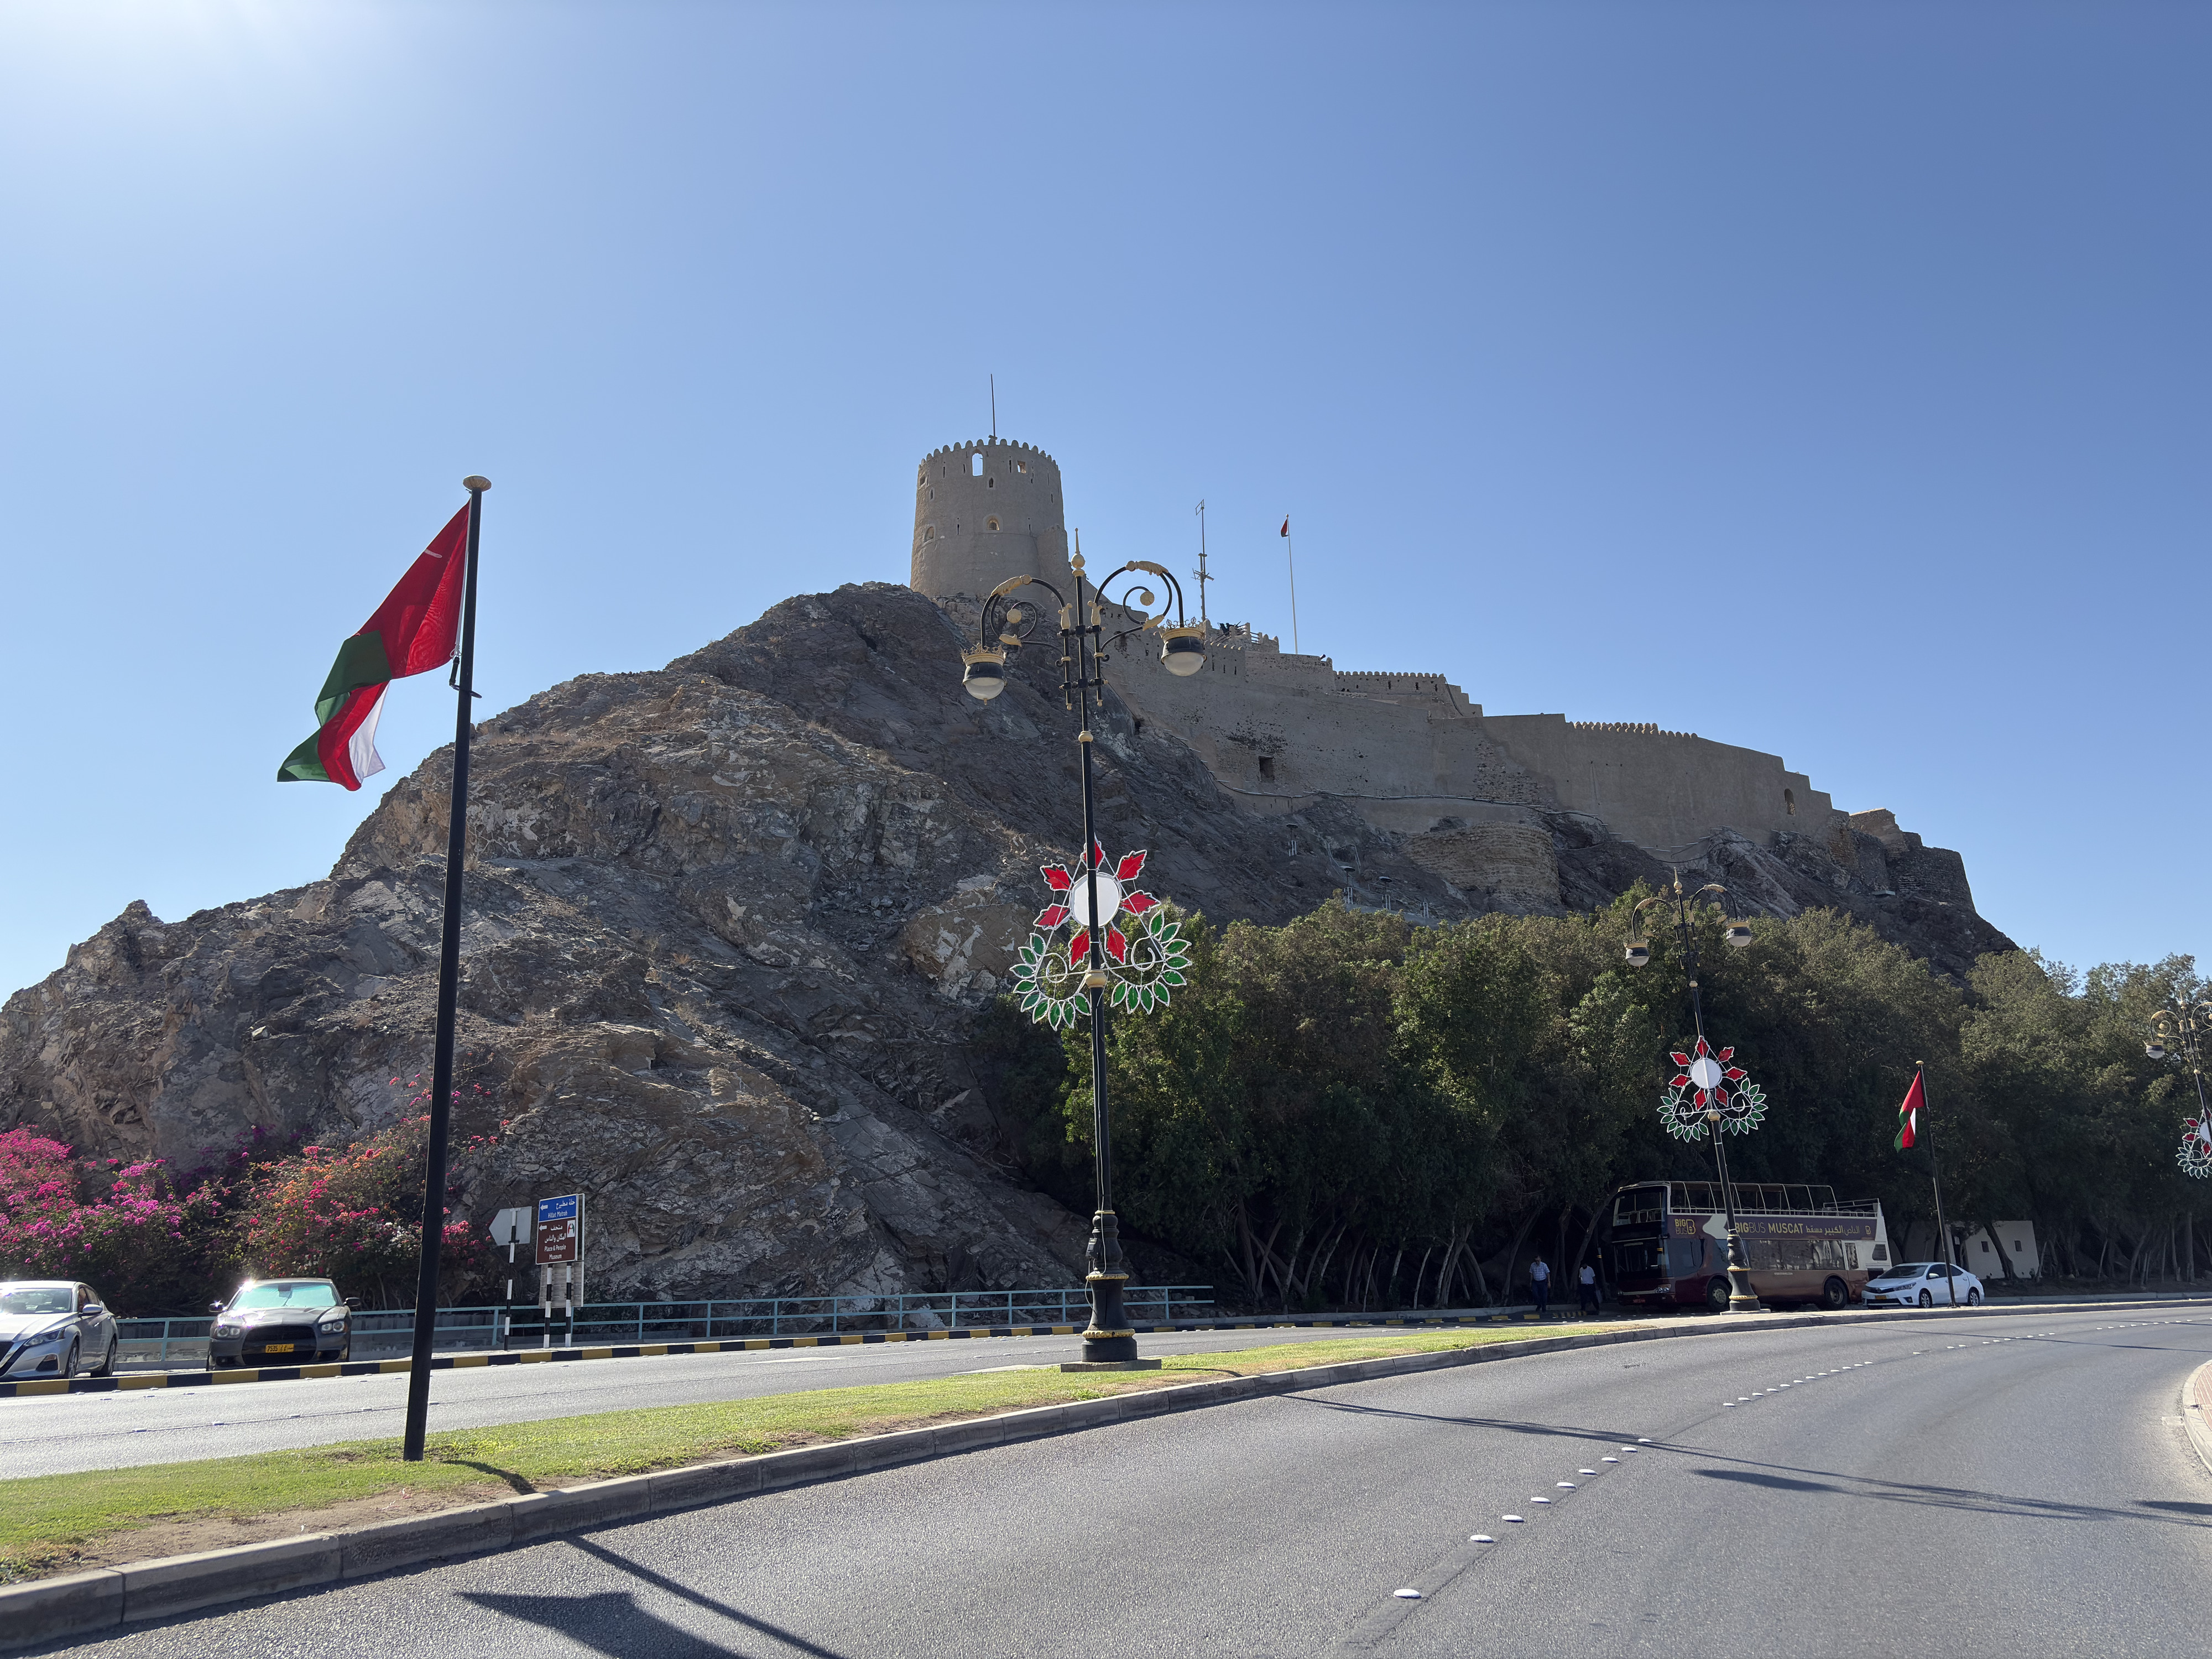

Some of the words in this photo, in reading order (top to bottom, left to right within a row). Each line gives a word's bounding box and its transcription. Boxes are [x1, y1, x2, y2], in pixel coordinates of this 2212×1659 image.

[556, 1201, 568, 1209] مطيرح
[1674, 1218, 1686, 1227] BIG
[1768, 1223, 1803, 1234] MUSCAT
[1824, 1225, 1844, 1235] الكبير
[545, 1235, 556, 1243] والناس
[557, 1233, 566, 1243] المكان
